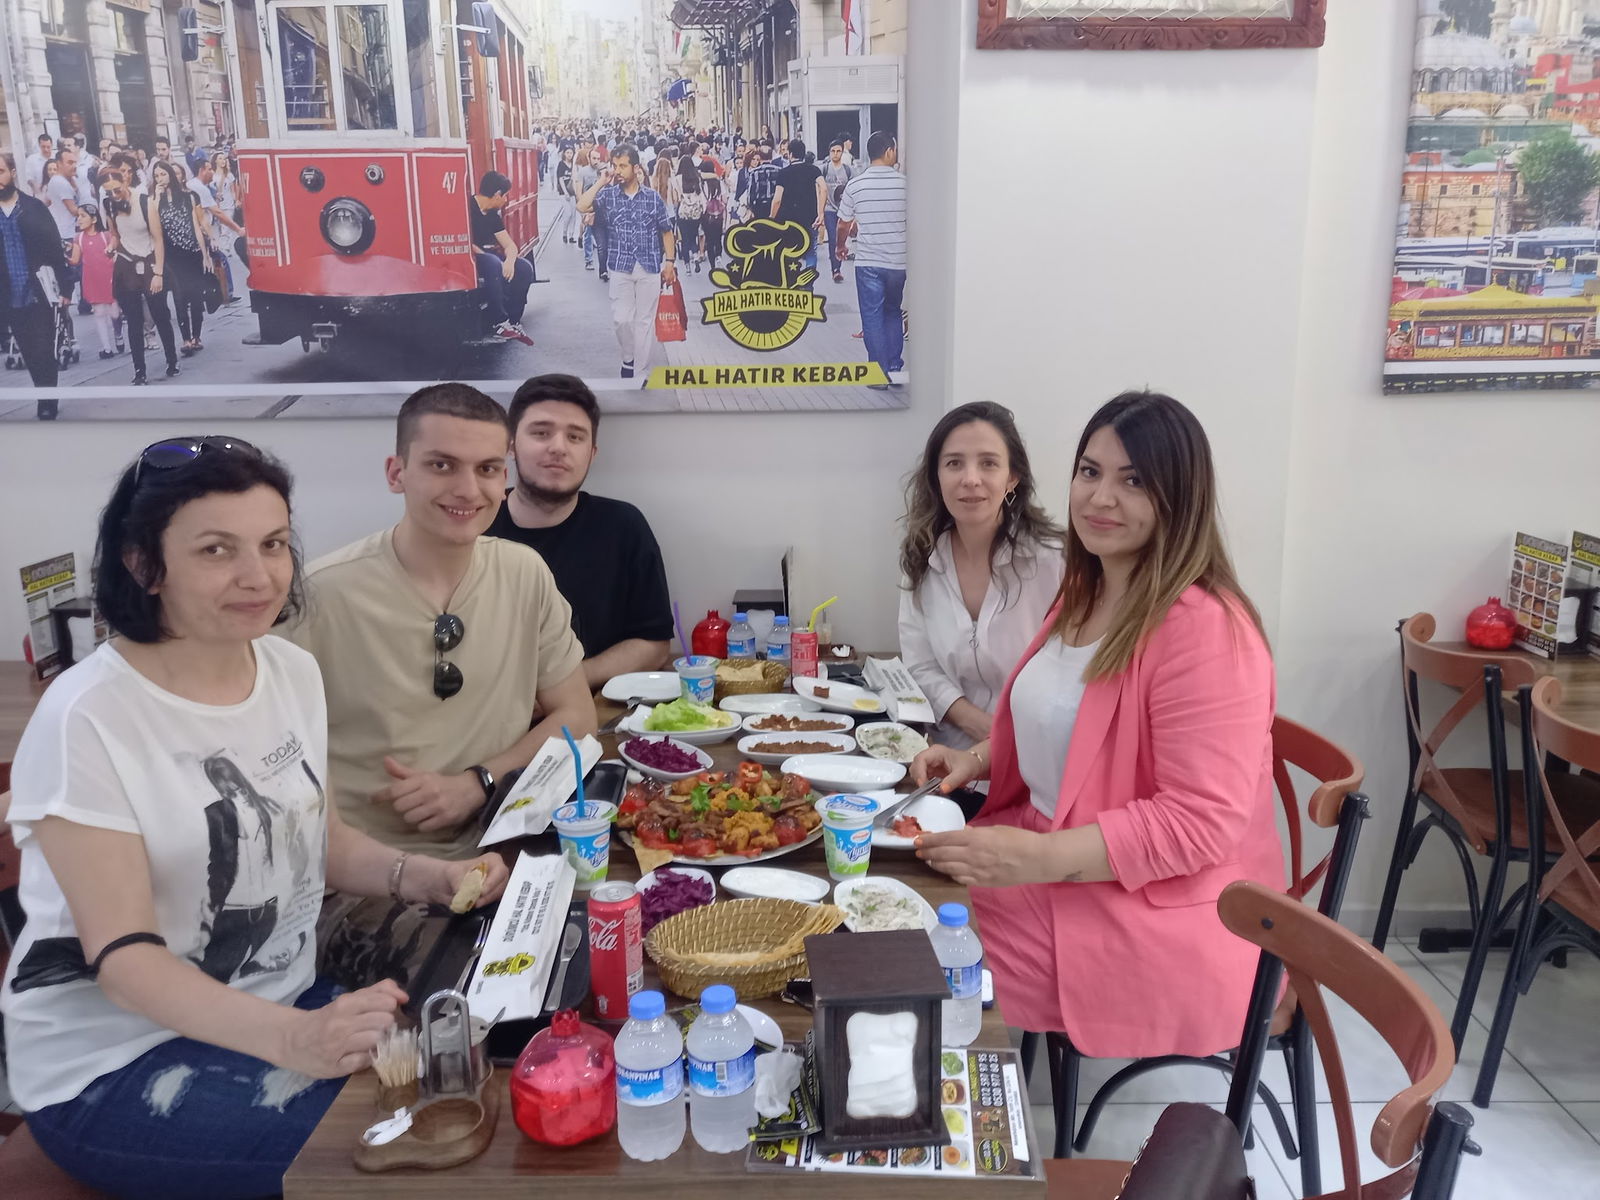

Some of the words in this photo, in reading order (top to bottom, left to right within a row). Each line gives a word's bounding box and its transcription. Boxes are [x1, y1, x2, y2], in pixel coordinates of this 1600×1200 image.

[443, 171, 457, 194] 47
[718, 294, 738, 312] HAL
[740, 292, 772, 308] HATIR
[774, 292, 809, 310] KEBAP
[665, 368, 709, 385] HAL
[715, 367, 785, 385] HATIR
[792, 365, 869, 383] KEBAP
[260, 729, 299, 767] TODAY
